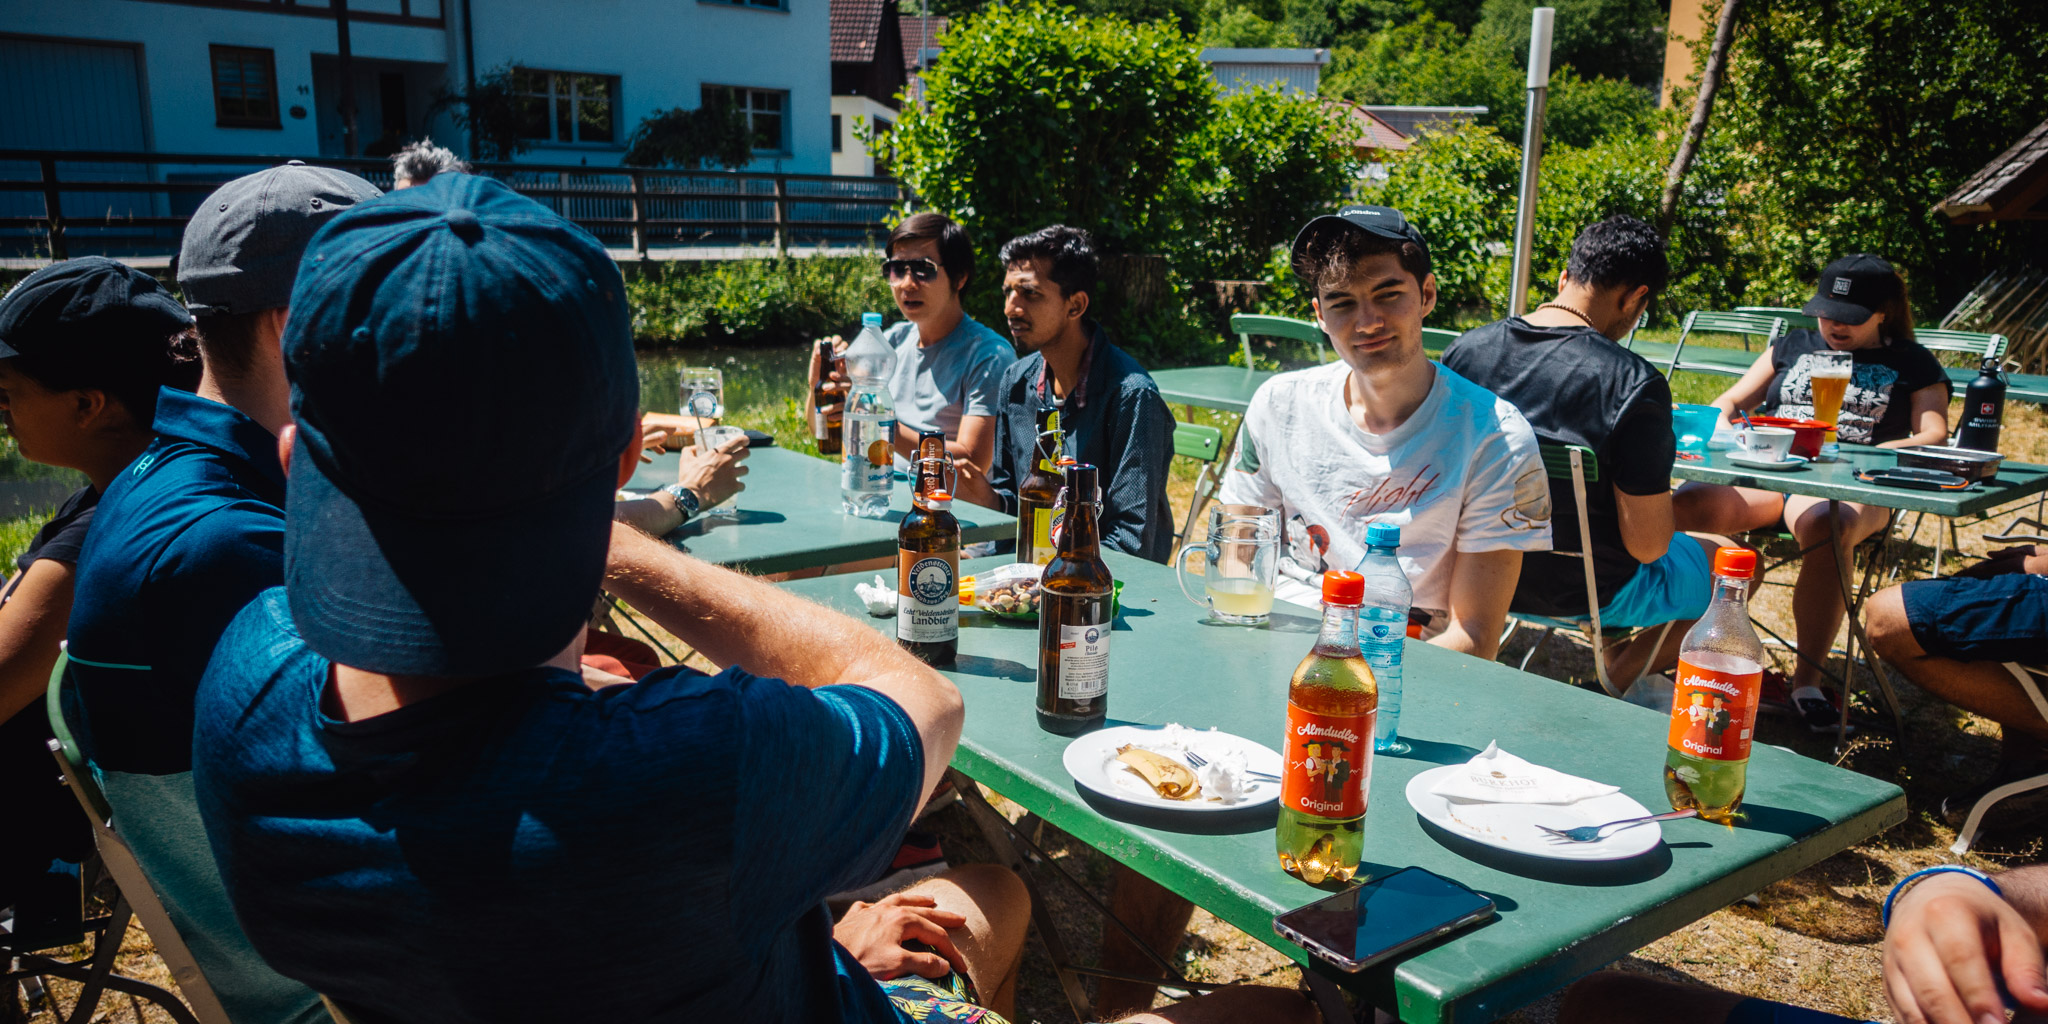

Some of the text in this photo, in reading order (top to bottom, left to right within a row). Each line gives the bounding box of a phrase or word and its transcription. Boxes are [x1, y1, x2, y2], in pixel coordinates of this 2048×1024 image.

[1339, 463, 1445, 525] Flight
[911, 560, 952, 577] Veldensteiner
[911, 615, 951, 626] Landbier
[1683, 675, 1741, 697] Almdudler
[1296, 722, 1359, 744] Almdudler
[1682, 738, 1723, 755] Original
[1300, 796, 1344, 813] Original
